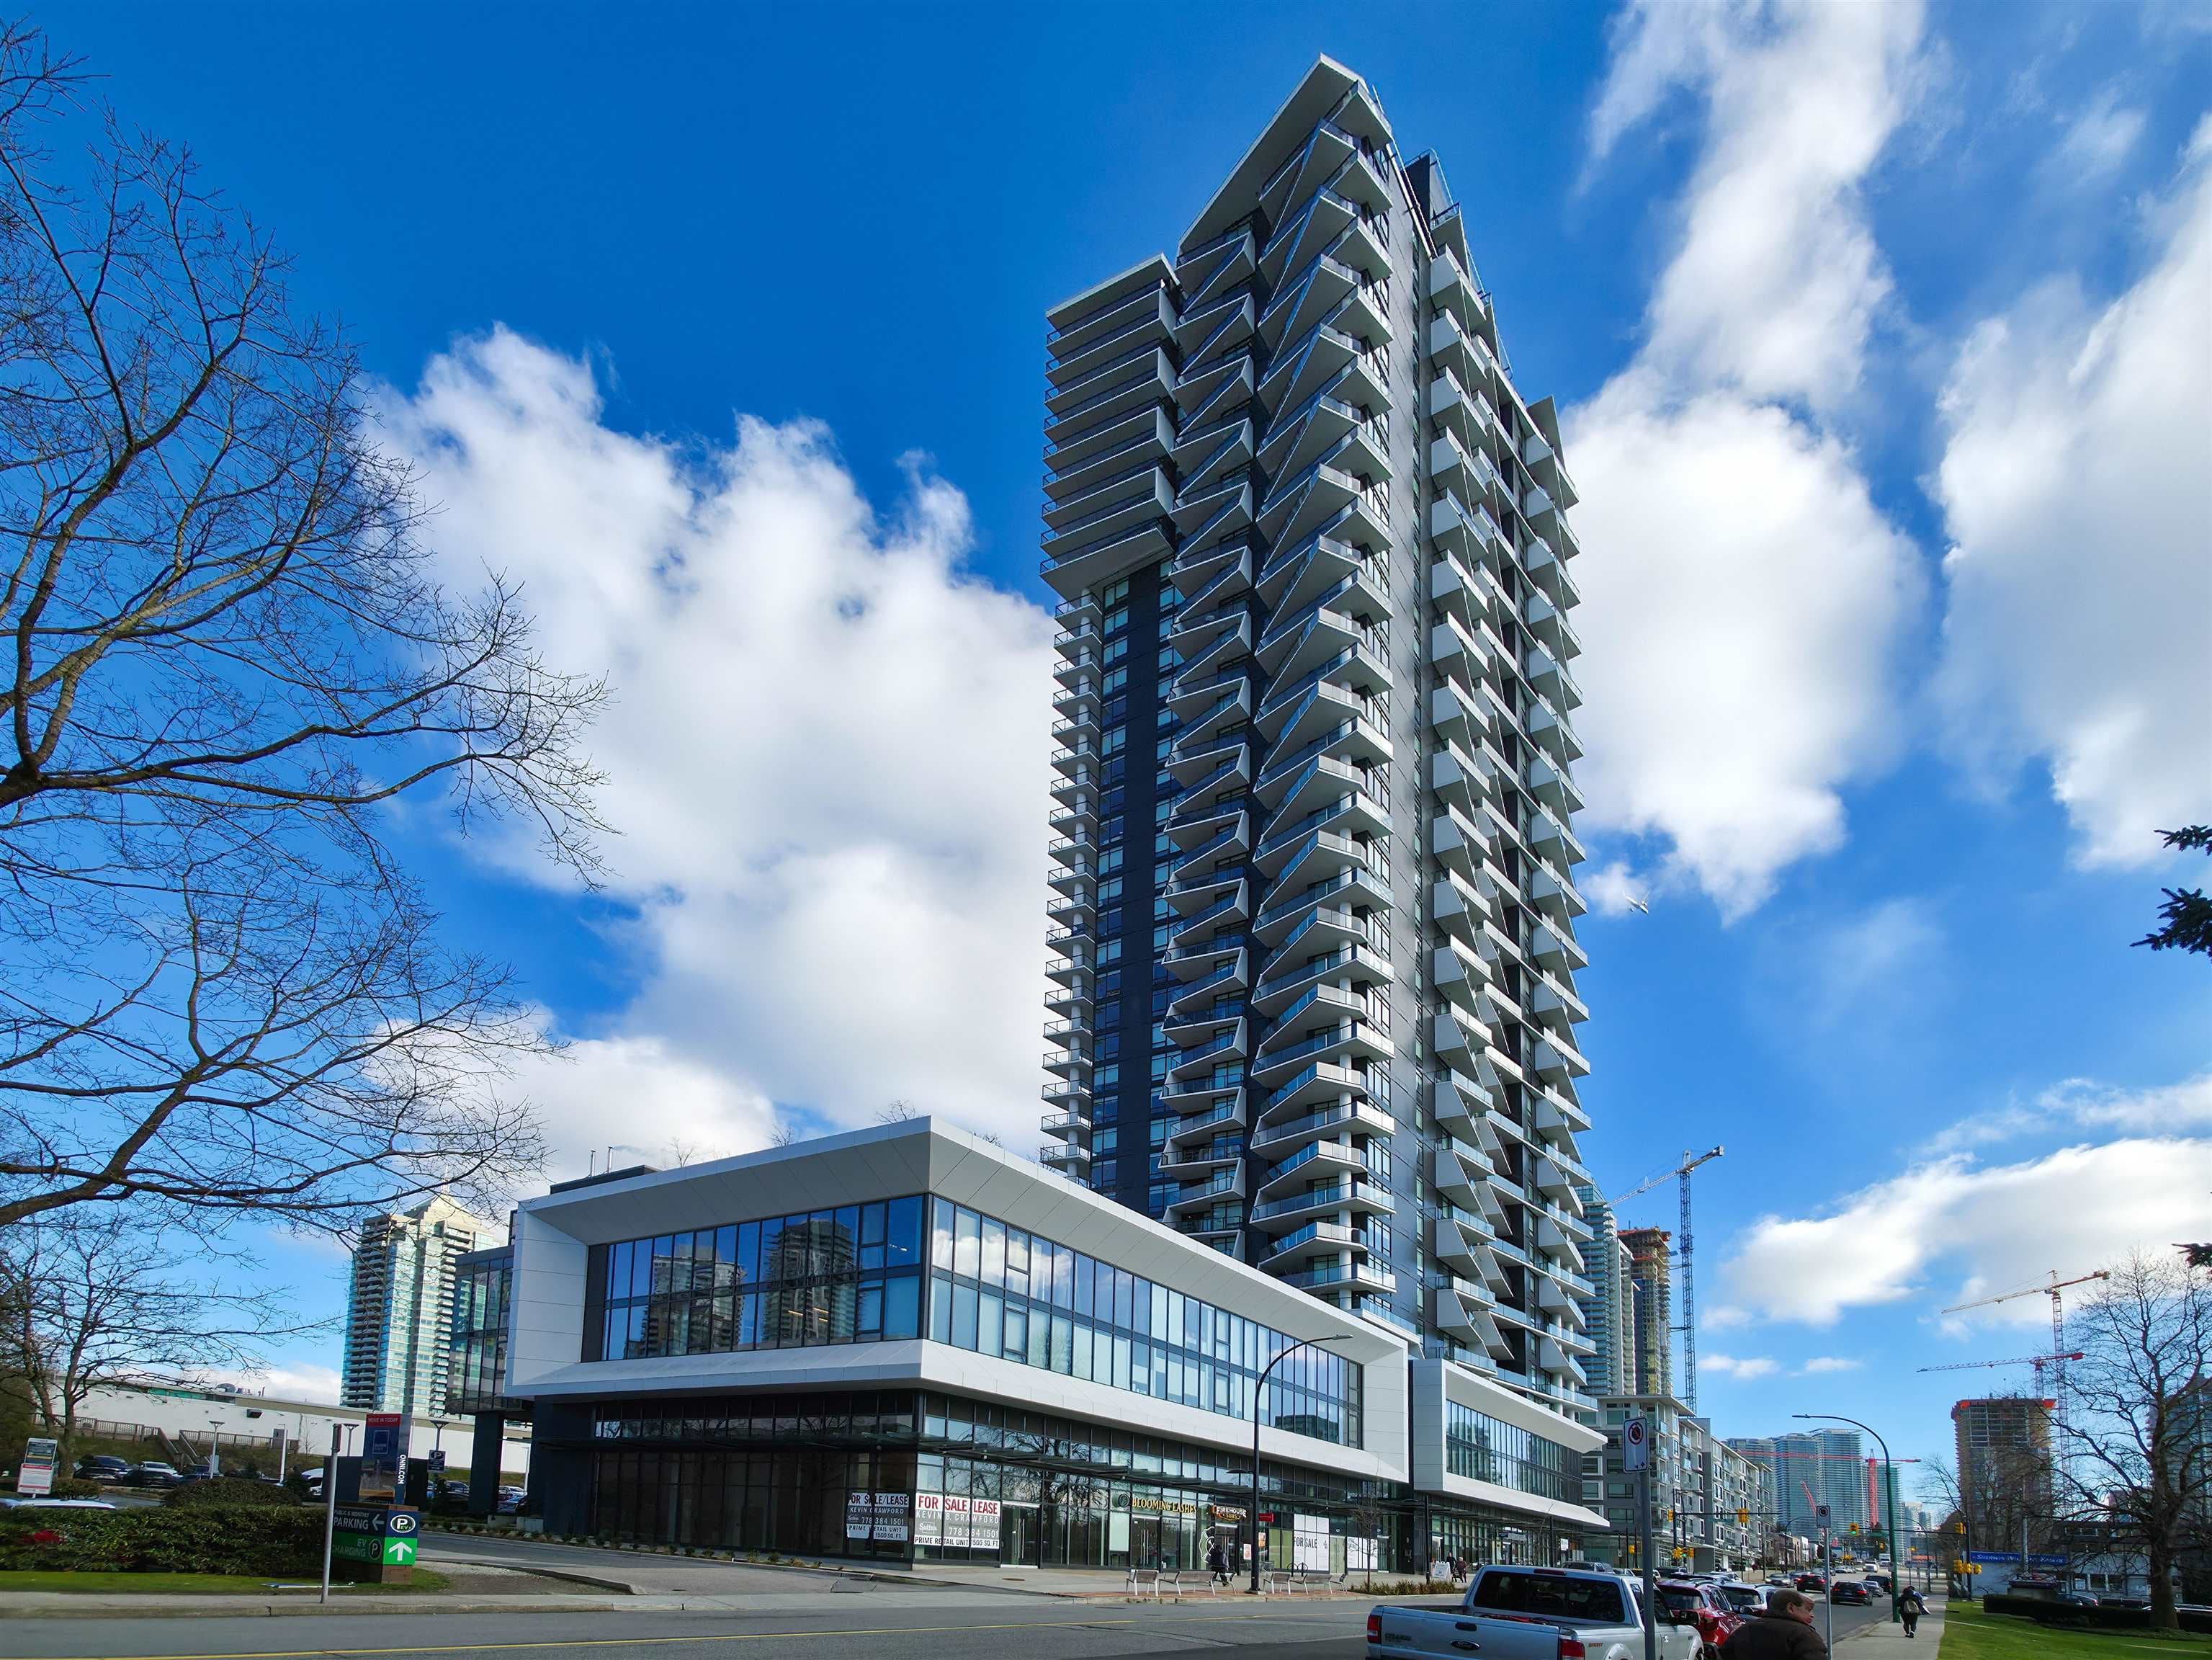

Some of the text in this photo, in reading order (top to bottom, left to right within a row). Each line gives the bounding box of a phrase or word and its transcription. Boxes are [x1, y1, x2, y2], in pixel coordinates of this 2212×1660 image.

[397, 1454, 406, 1484] ONNI.COM
[918, 1495, 939, 1509] FOR
[1132, 1497, 1196, 1513] BLOOMING LASHES
[916, 1509, 942, 1520] KEVIN
[955, 1514, 999, 1524] CRAWFORD
[1216, 1506, 1247, 1518] FIREHOUSE
[333, 1516, 369, 1530] PARKING
[396, 1518, 408, 1530] P
[949, 1527, 998, 1538] 778 384 1501
[357, 1538, 367, 1547] EV
[1304, 1538, 1317, 1548] SALE
